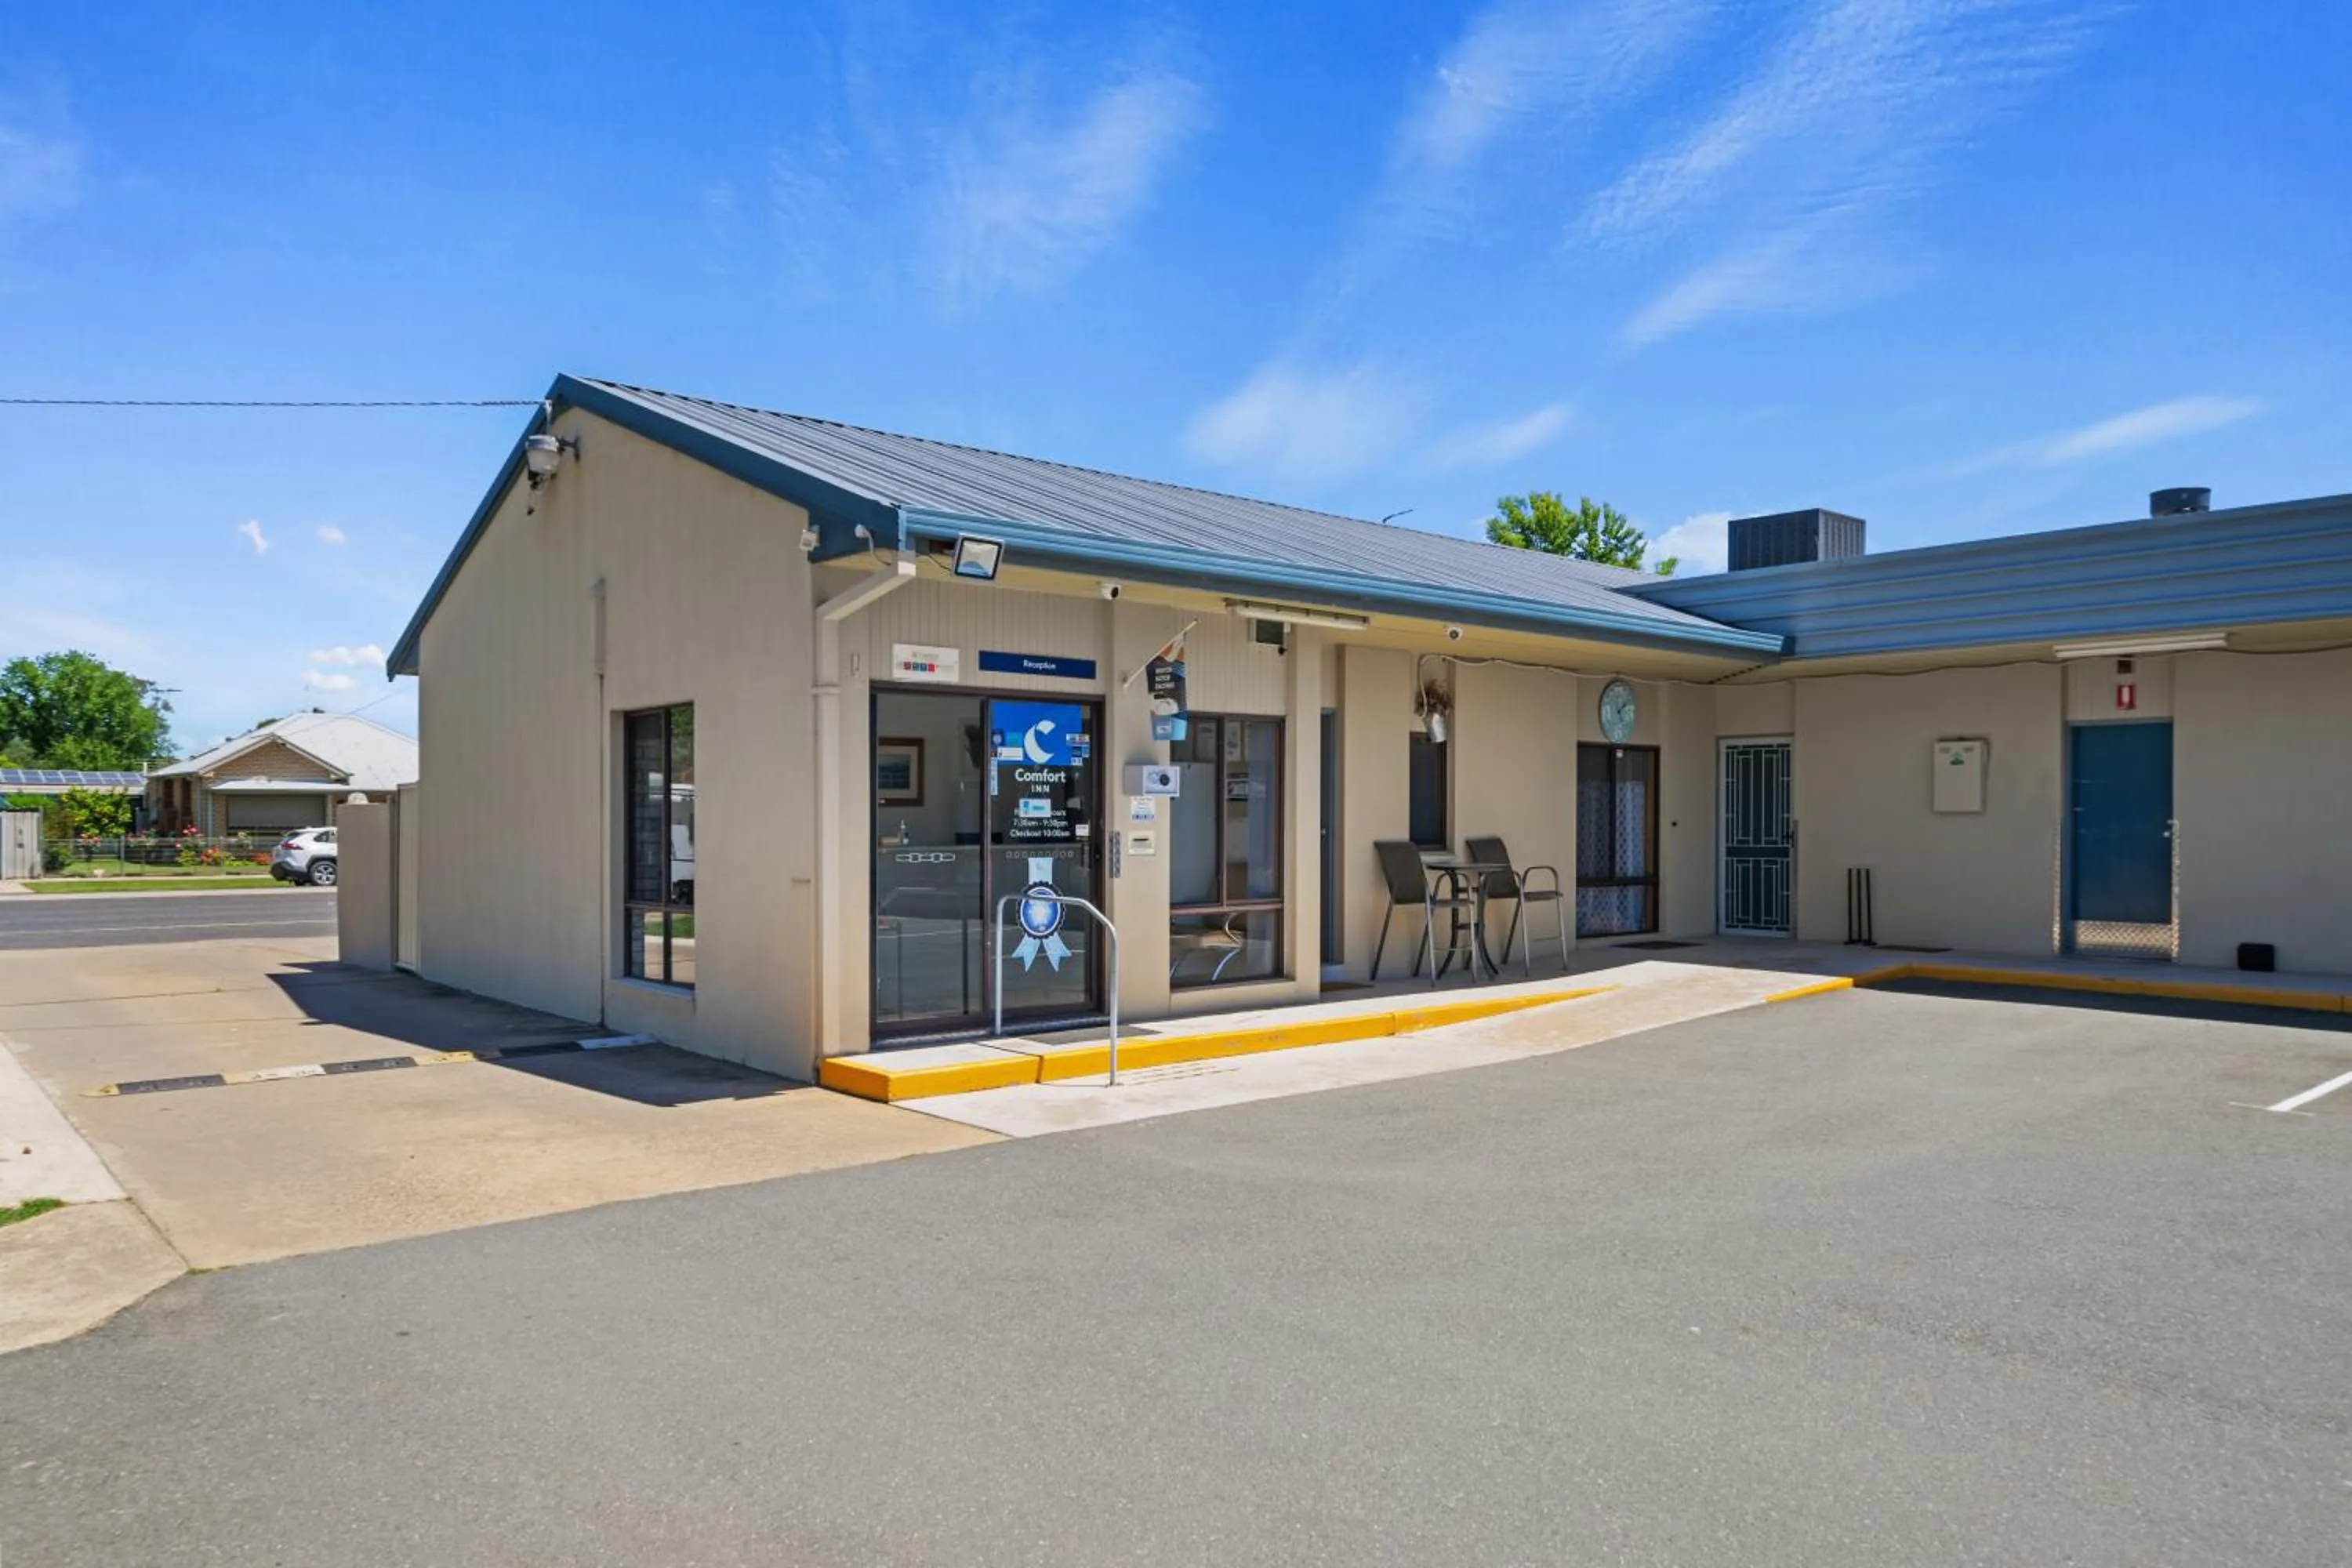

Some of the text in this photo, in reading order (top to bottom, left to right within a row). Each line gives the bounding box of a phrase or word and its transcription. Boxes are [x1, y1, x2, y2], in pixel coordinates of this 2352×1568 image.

[1023, 659, 1057, 670] Reception
[1015, 768, 1066, 783] Comfort
[1010, 829, 1041, 837] Checkout
